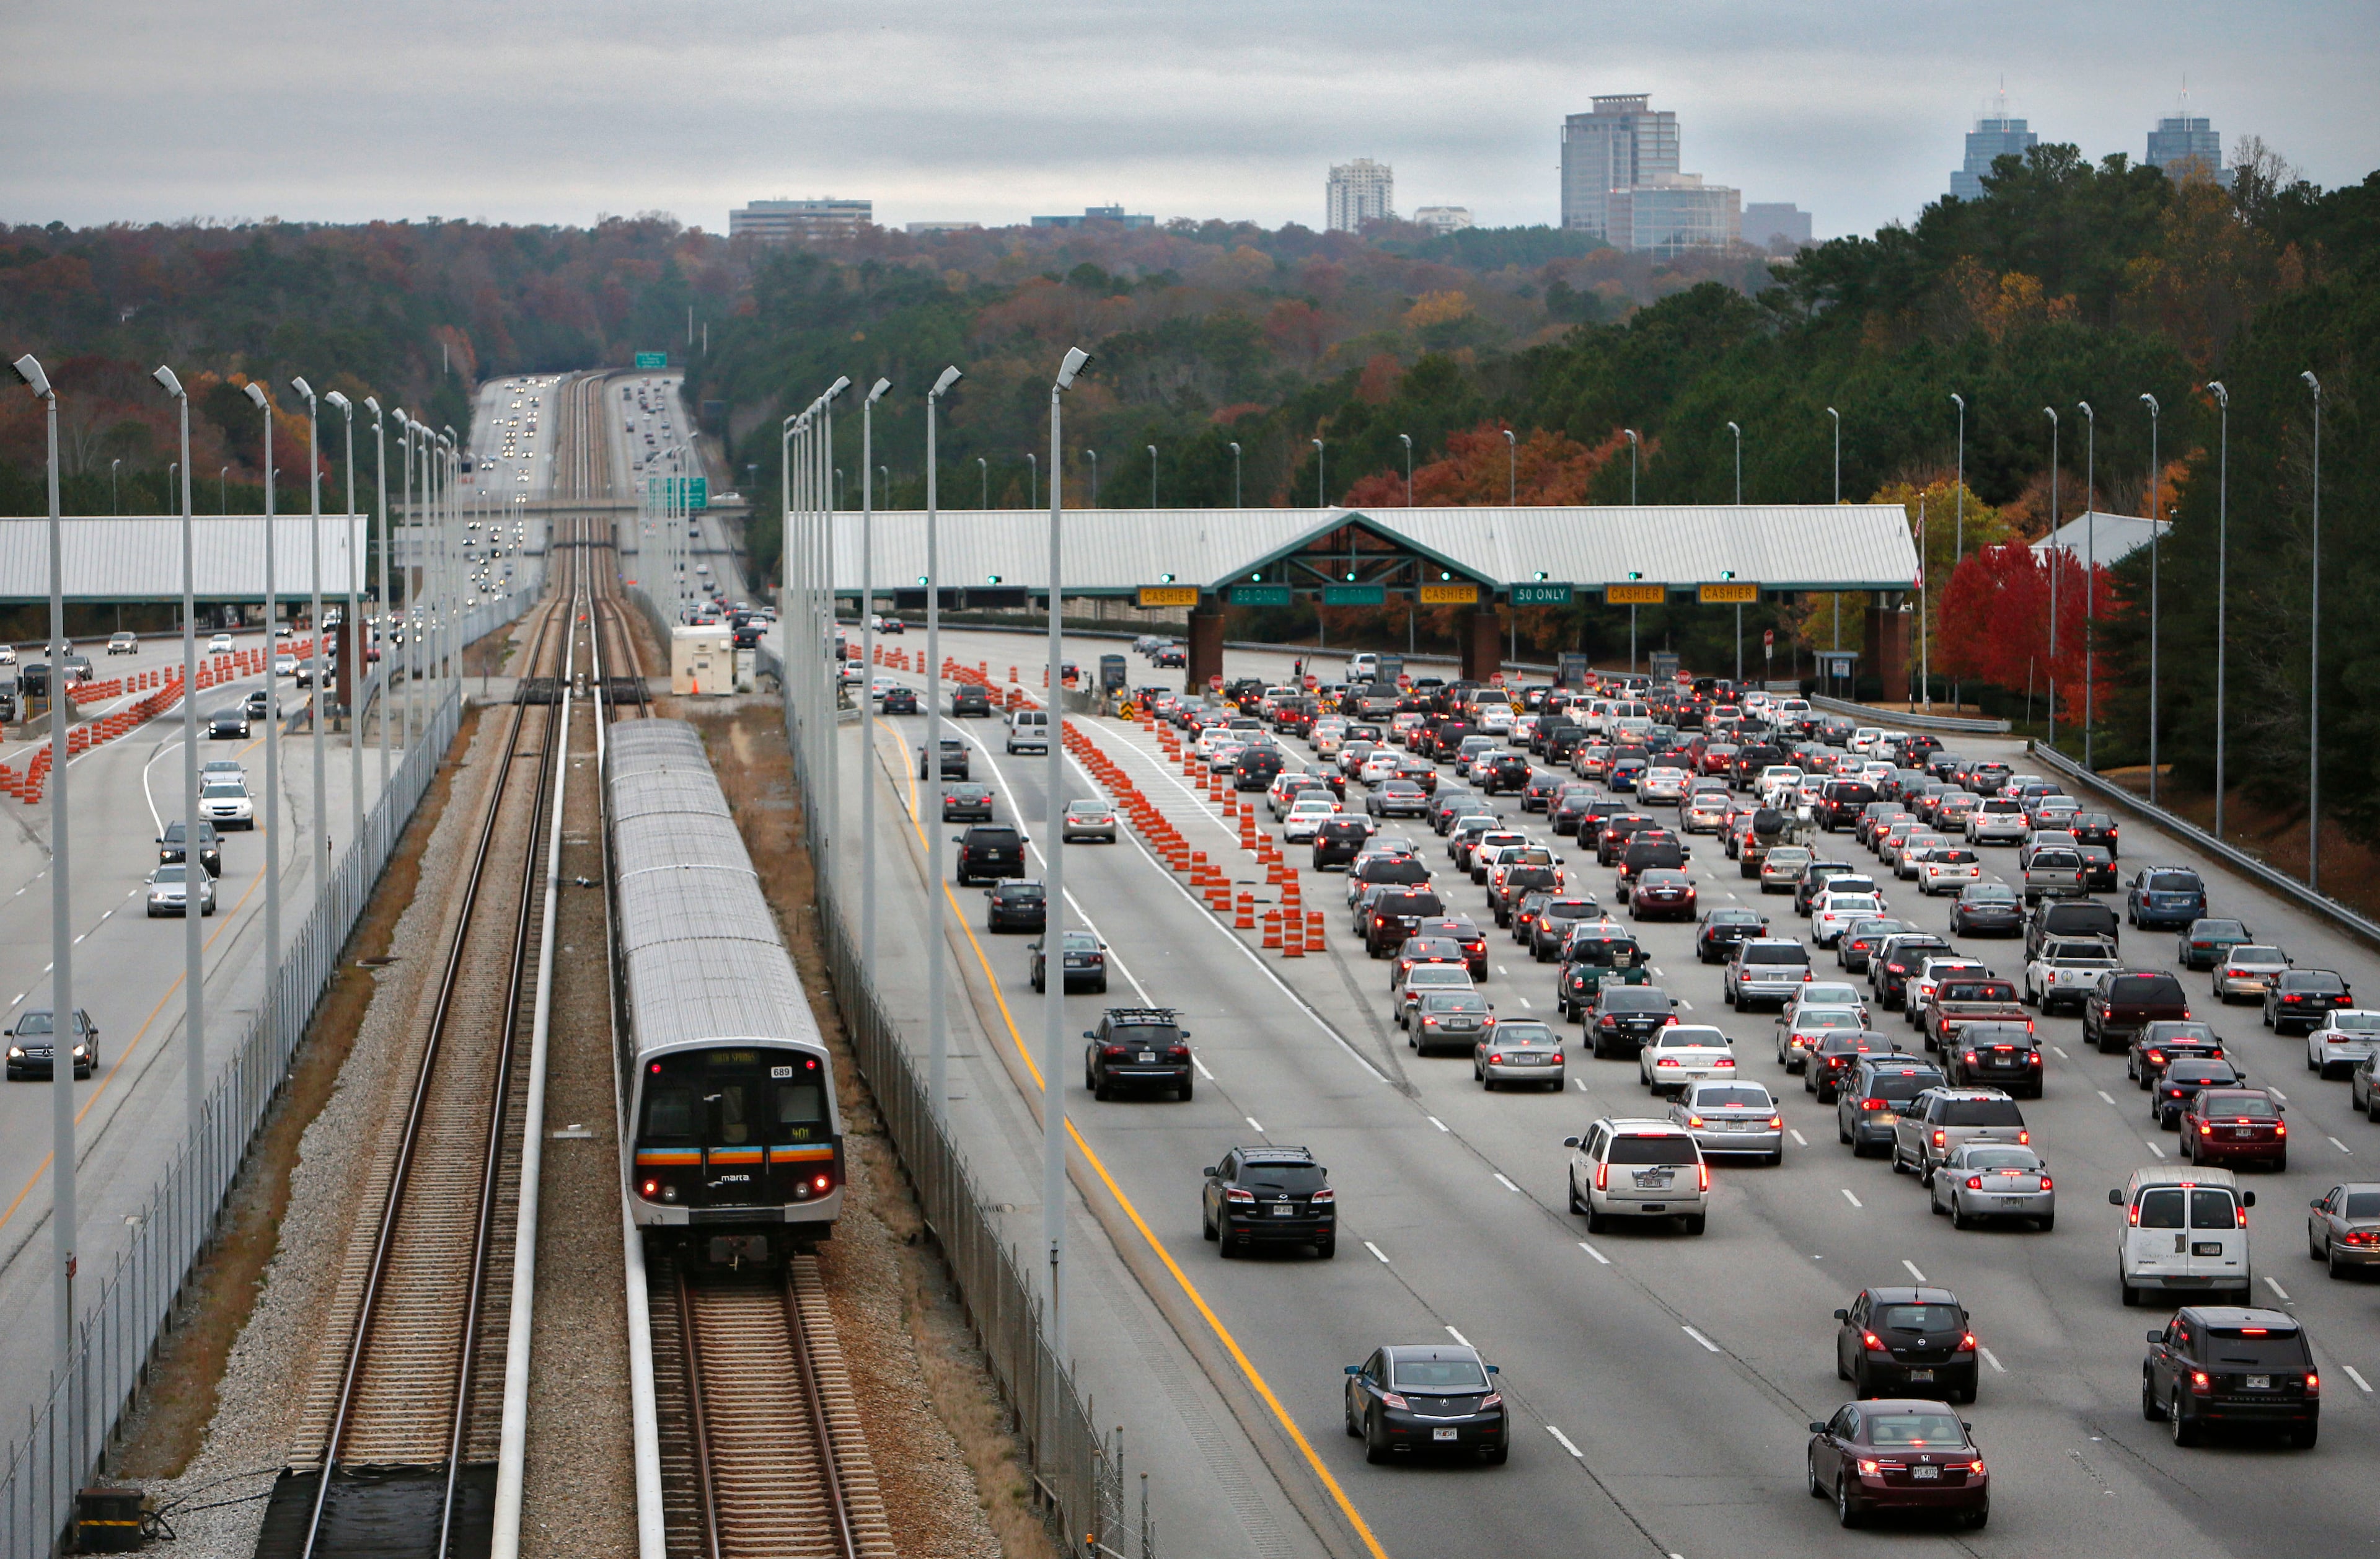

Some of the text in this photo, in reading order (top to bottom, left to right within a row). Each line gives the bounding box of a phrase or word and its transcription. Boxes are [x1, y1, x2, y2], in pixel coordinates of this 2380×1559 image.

[1144, 590, 1192, 601] CASHIER
[1426, 588, 1473, 599] CASHIER
[1517, 588, 1566, 600] .50 ONLY
[1611, 587, 1659, 599] CASHIER
[1704, 586, 1753, 599] CASHIER
[774, 1067, 790, 1076] 689
[792, 1128, 809, 1139] 401
